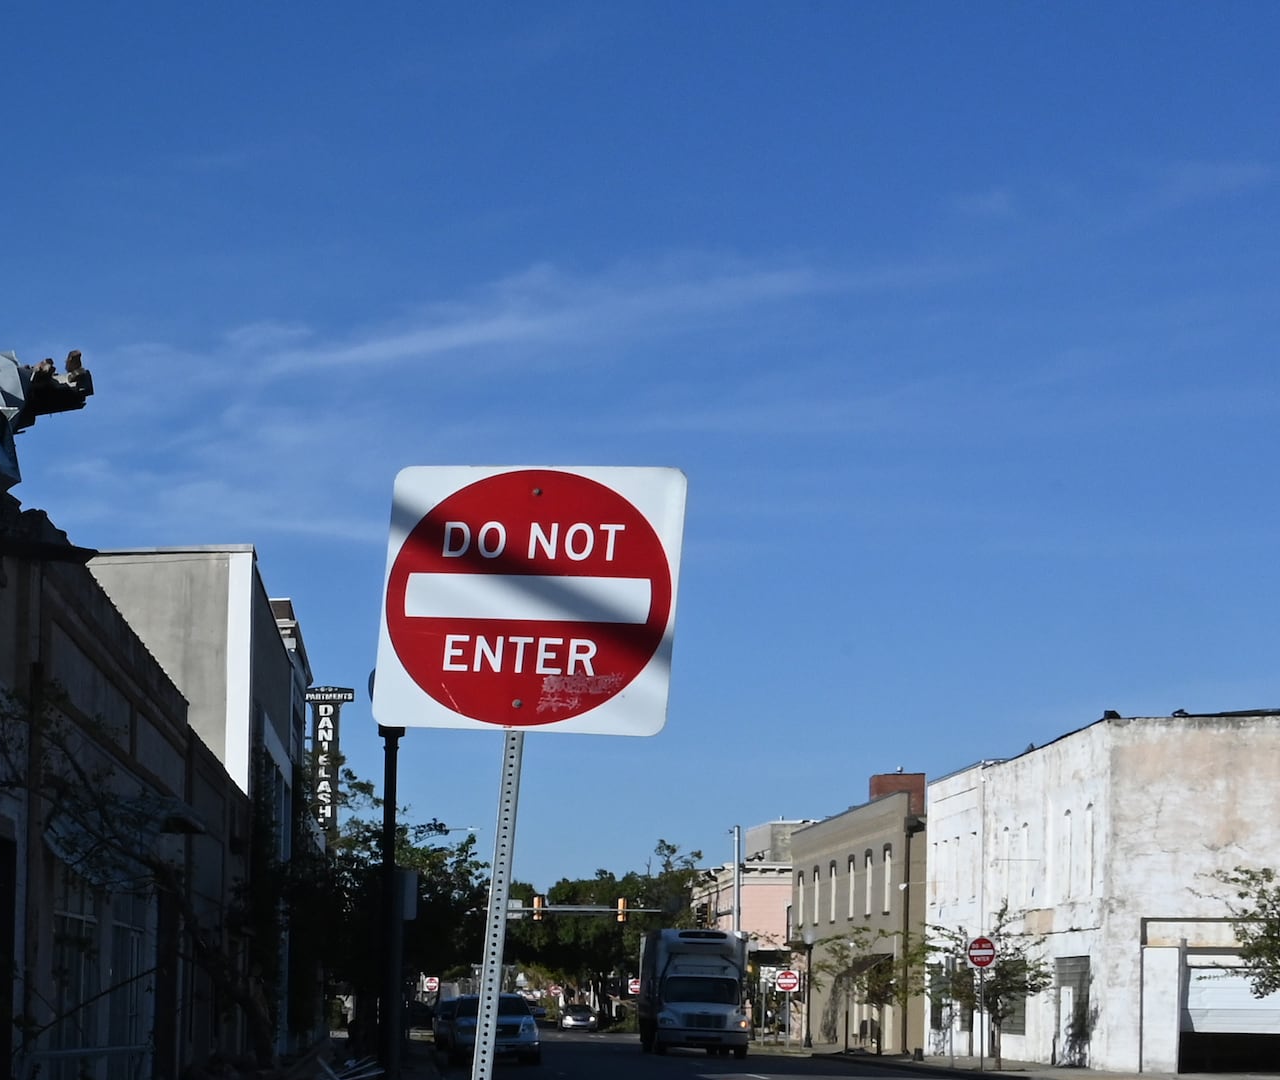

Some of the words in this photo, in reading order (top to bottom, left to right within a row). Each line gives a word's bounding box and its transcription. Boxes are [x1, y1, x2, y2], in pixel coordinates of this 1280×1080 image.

[442, 521, 507, 559] DO
[527, 522, 626, 561] NOT
[442, 634, 598, 676] ENTER
